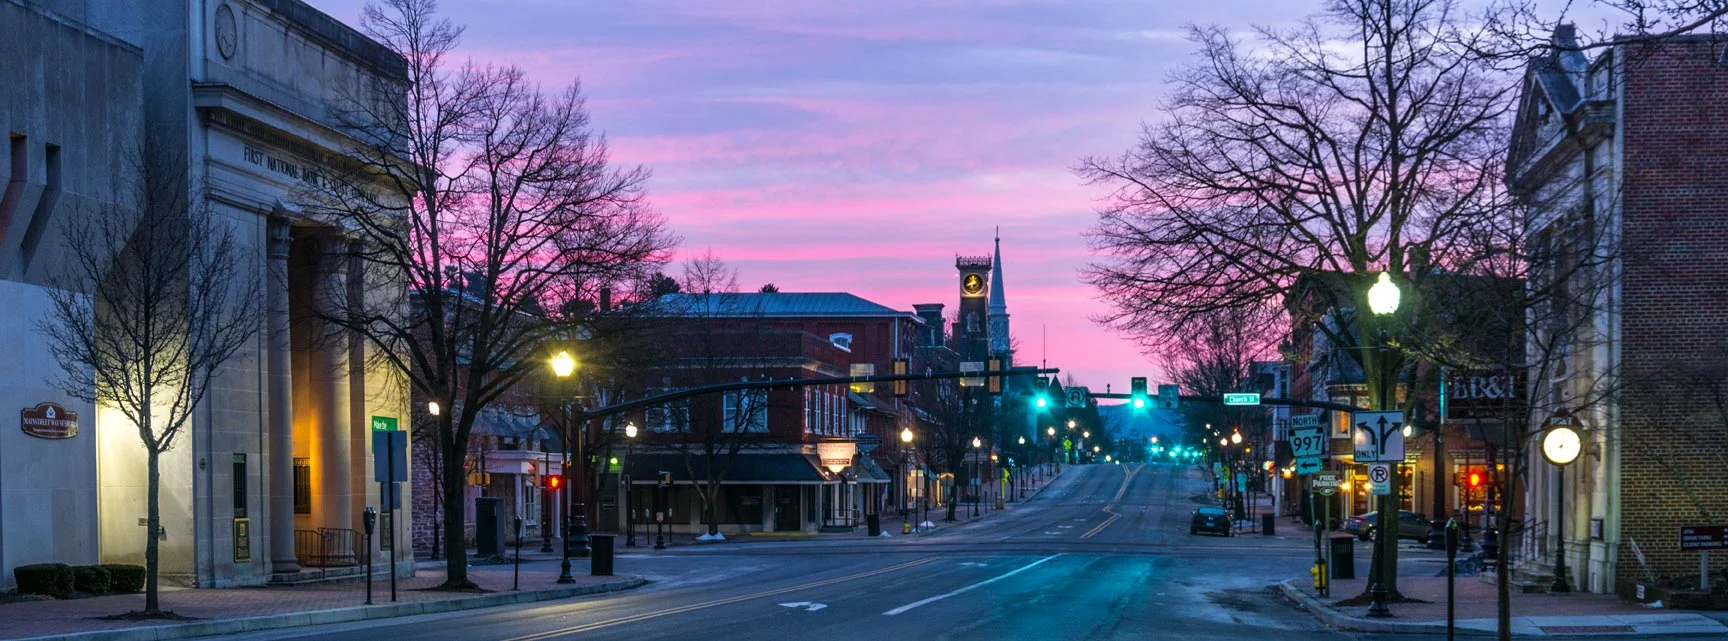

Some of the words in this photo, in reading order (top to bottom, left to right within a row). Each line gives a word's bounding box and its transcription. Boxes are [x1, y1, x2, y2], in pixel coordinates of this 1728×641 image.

[244, 147, 264, 166] FIRST
[267, 156, 299, 179] NATIONAL
[302, 166, 318, 186] BANK
[24, 417, 50, 426] MAINSTREET
[1292, 416, 1318, 426] NORTH
[1293, 435, 1322, 452] 997
[1355, 449, 1377, 459] ONLY
[1312, 479, 1342, 487] PARKING
